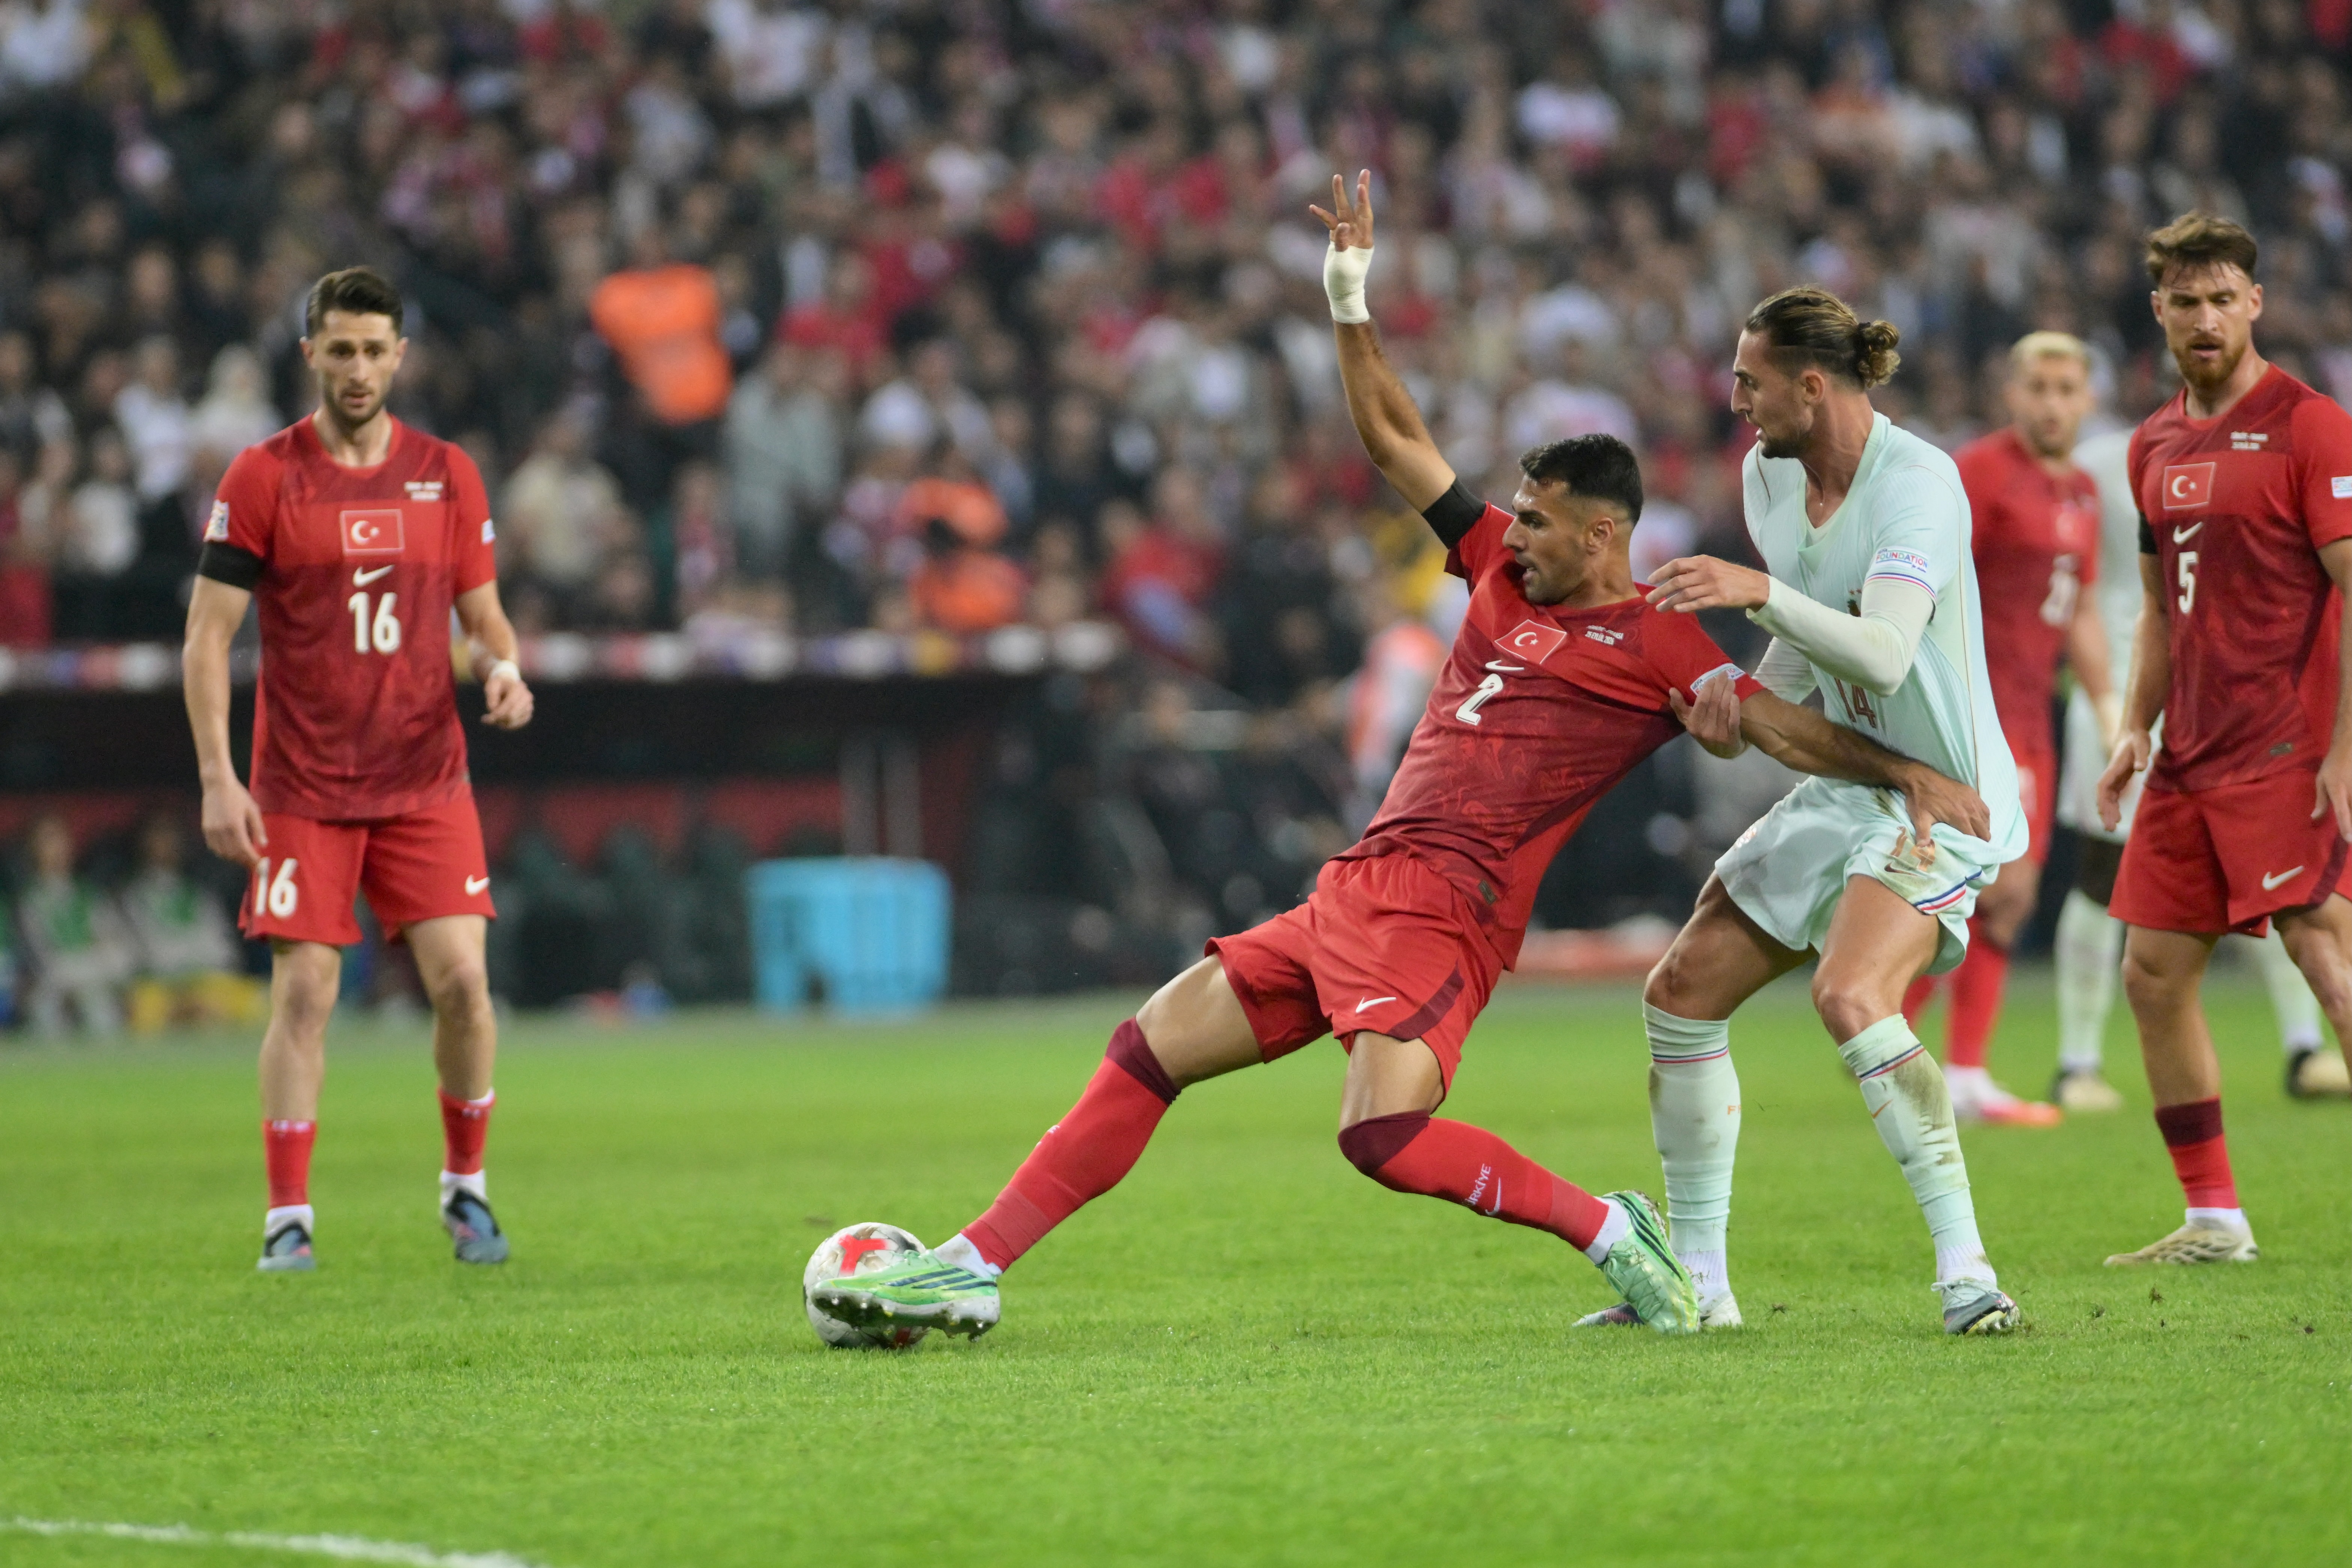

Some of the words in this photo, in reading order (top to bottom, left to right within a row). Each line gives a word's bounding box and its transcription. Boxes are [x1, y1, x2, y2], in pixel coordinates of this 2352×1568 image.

[1876, 552, 1928, 568] FOUNDATION
[2179, 551, 2199, 614] 5
[348, 592, 401, 655] 16
[1456, 673, 1503, 726] 2
[1834, 677, 1876, 729] 14
[256, 857, 298, 919] 16
